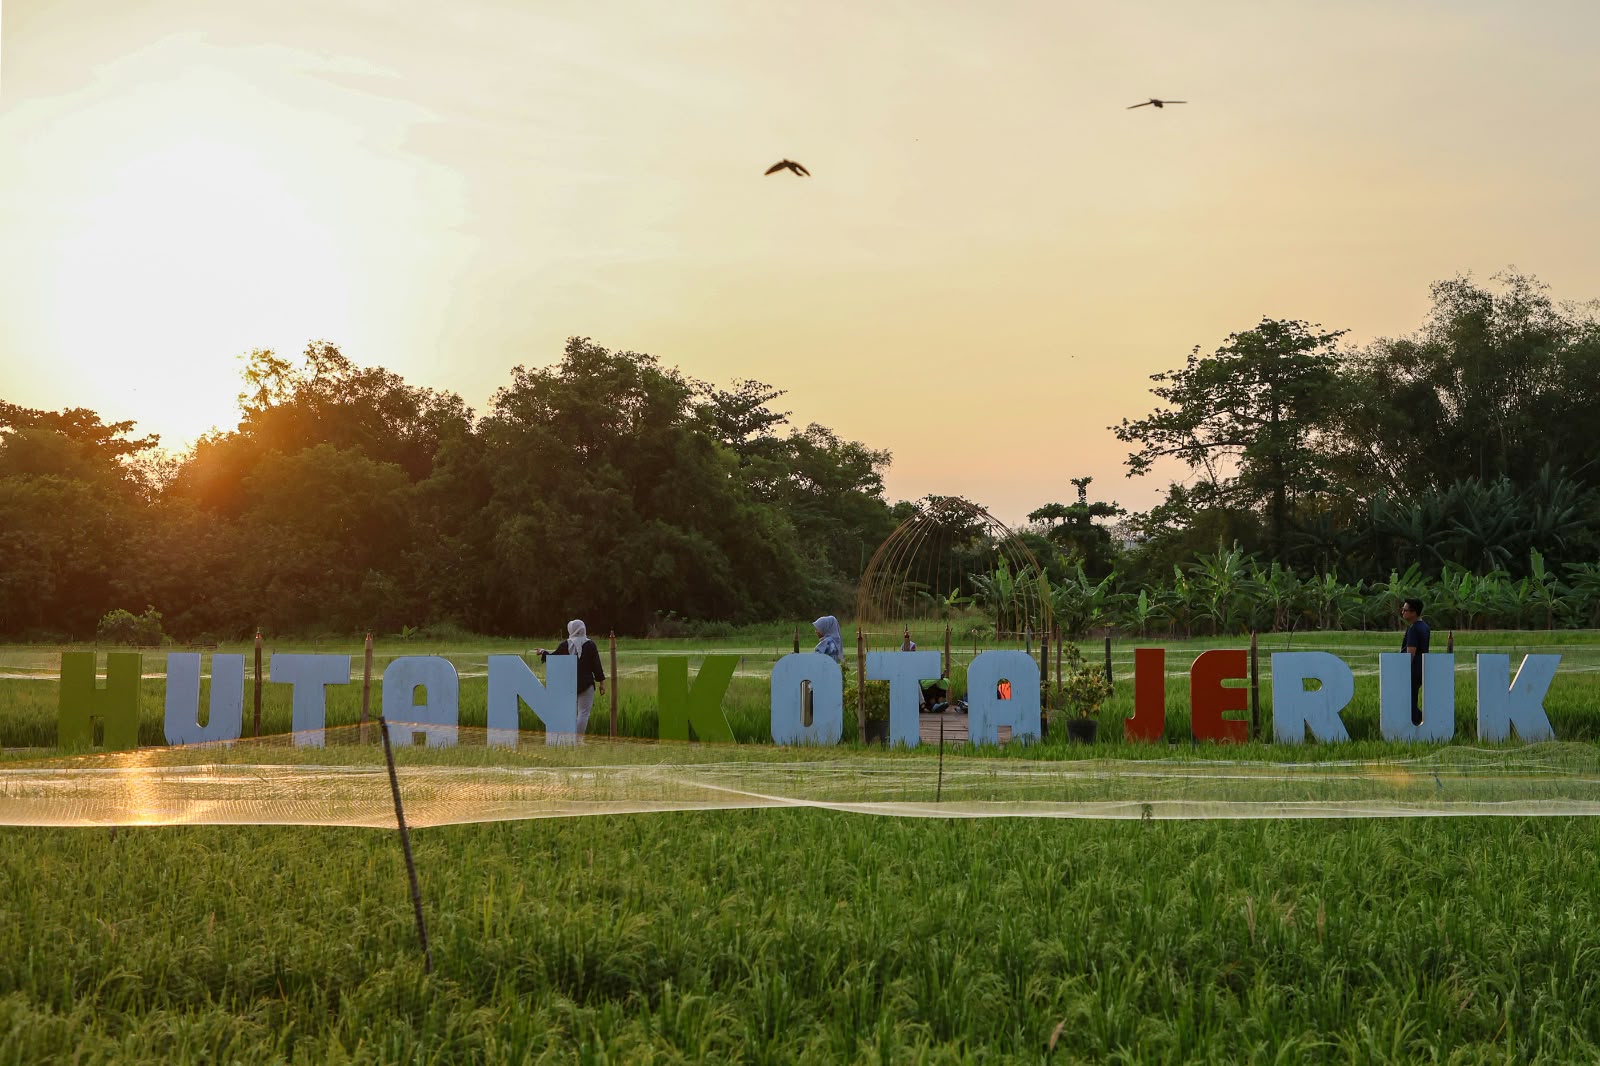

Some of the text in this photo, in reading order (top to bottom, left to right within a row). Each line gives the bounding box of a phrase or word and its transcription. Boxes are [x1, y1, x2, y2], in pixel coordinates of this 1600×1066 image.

[58, 648, 1562, 748] HUTAN KOTA JERUK
